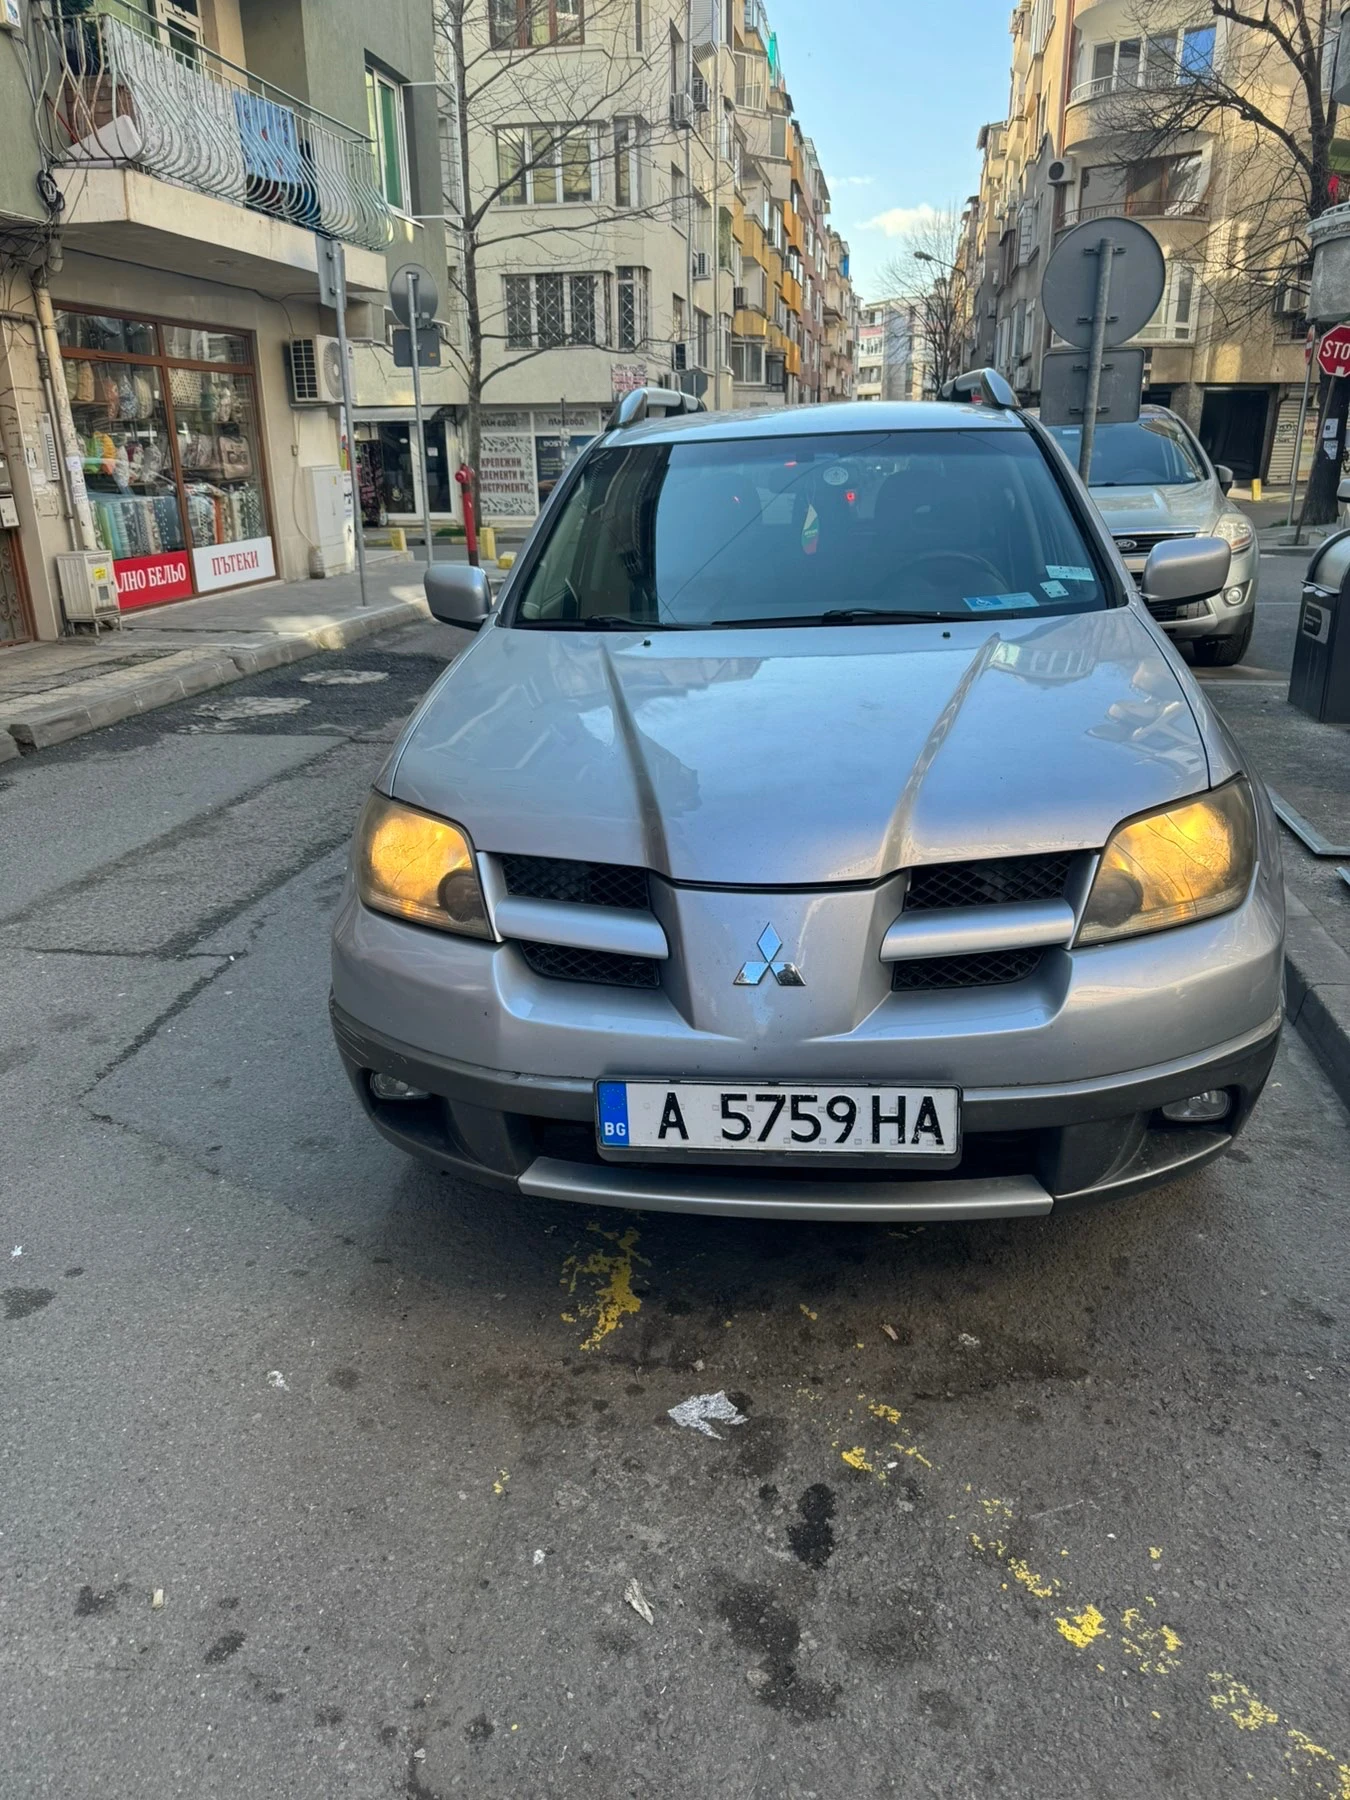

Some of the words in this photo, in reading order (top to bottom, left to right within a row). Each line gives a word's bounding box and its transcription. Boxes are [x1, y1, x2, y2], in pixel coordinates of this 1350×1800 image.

[1322, 339, 1350, 361] STO
[481, 457, 522, 468] КРЕПЕЖНИ
[480, 470, 518, 480] ЕЛЕМЕНТИ
[211, 550, 260, 576] ПЪТЕКИ
[116, 570, 146, 593] ЛНО
[147, 563, 187, 588] БЕЛЬО
[657, 1092, 689, 1141] A
[604, 1121, 626, 1136] BG
